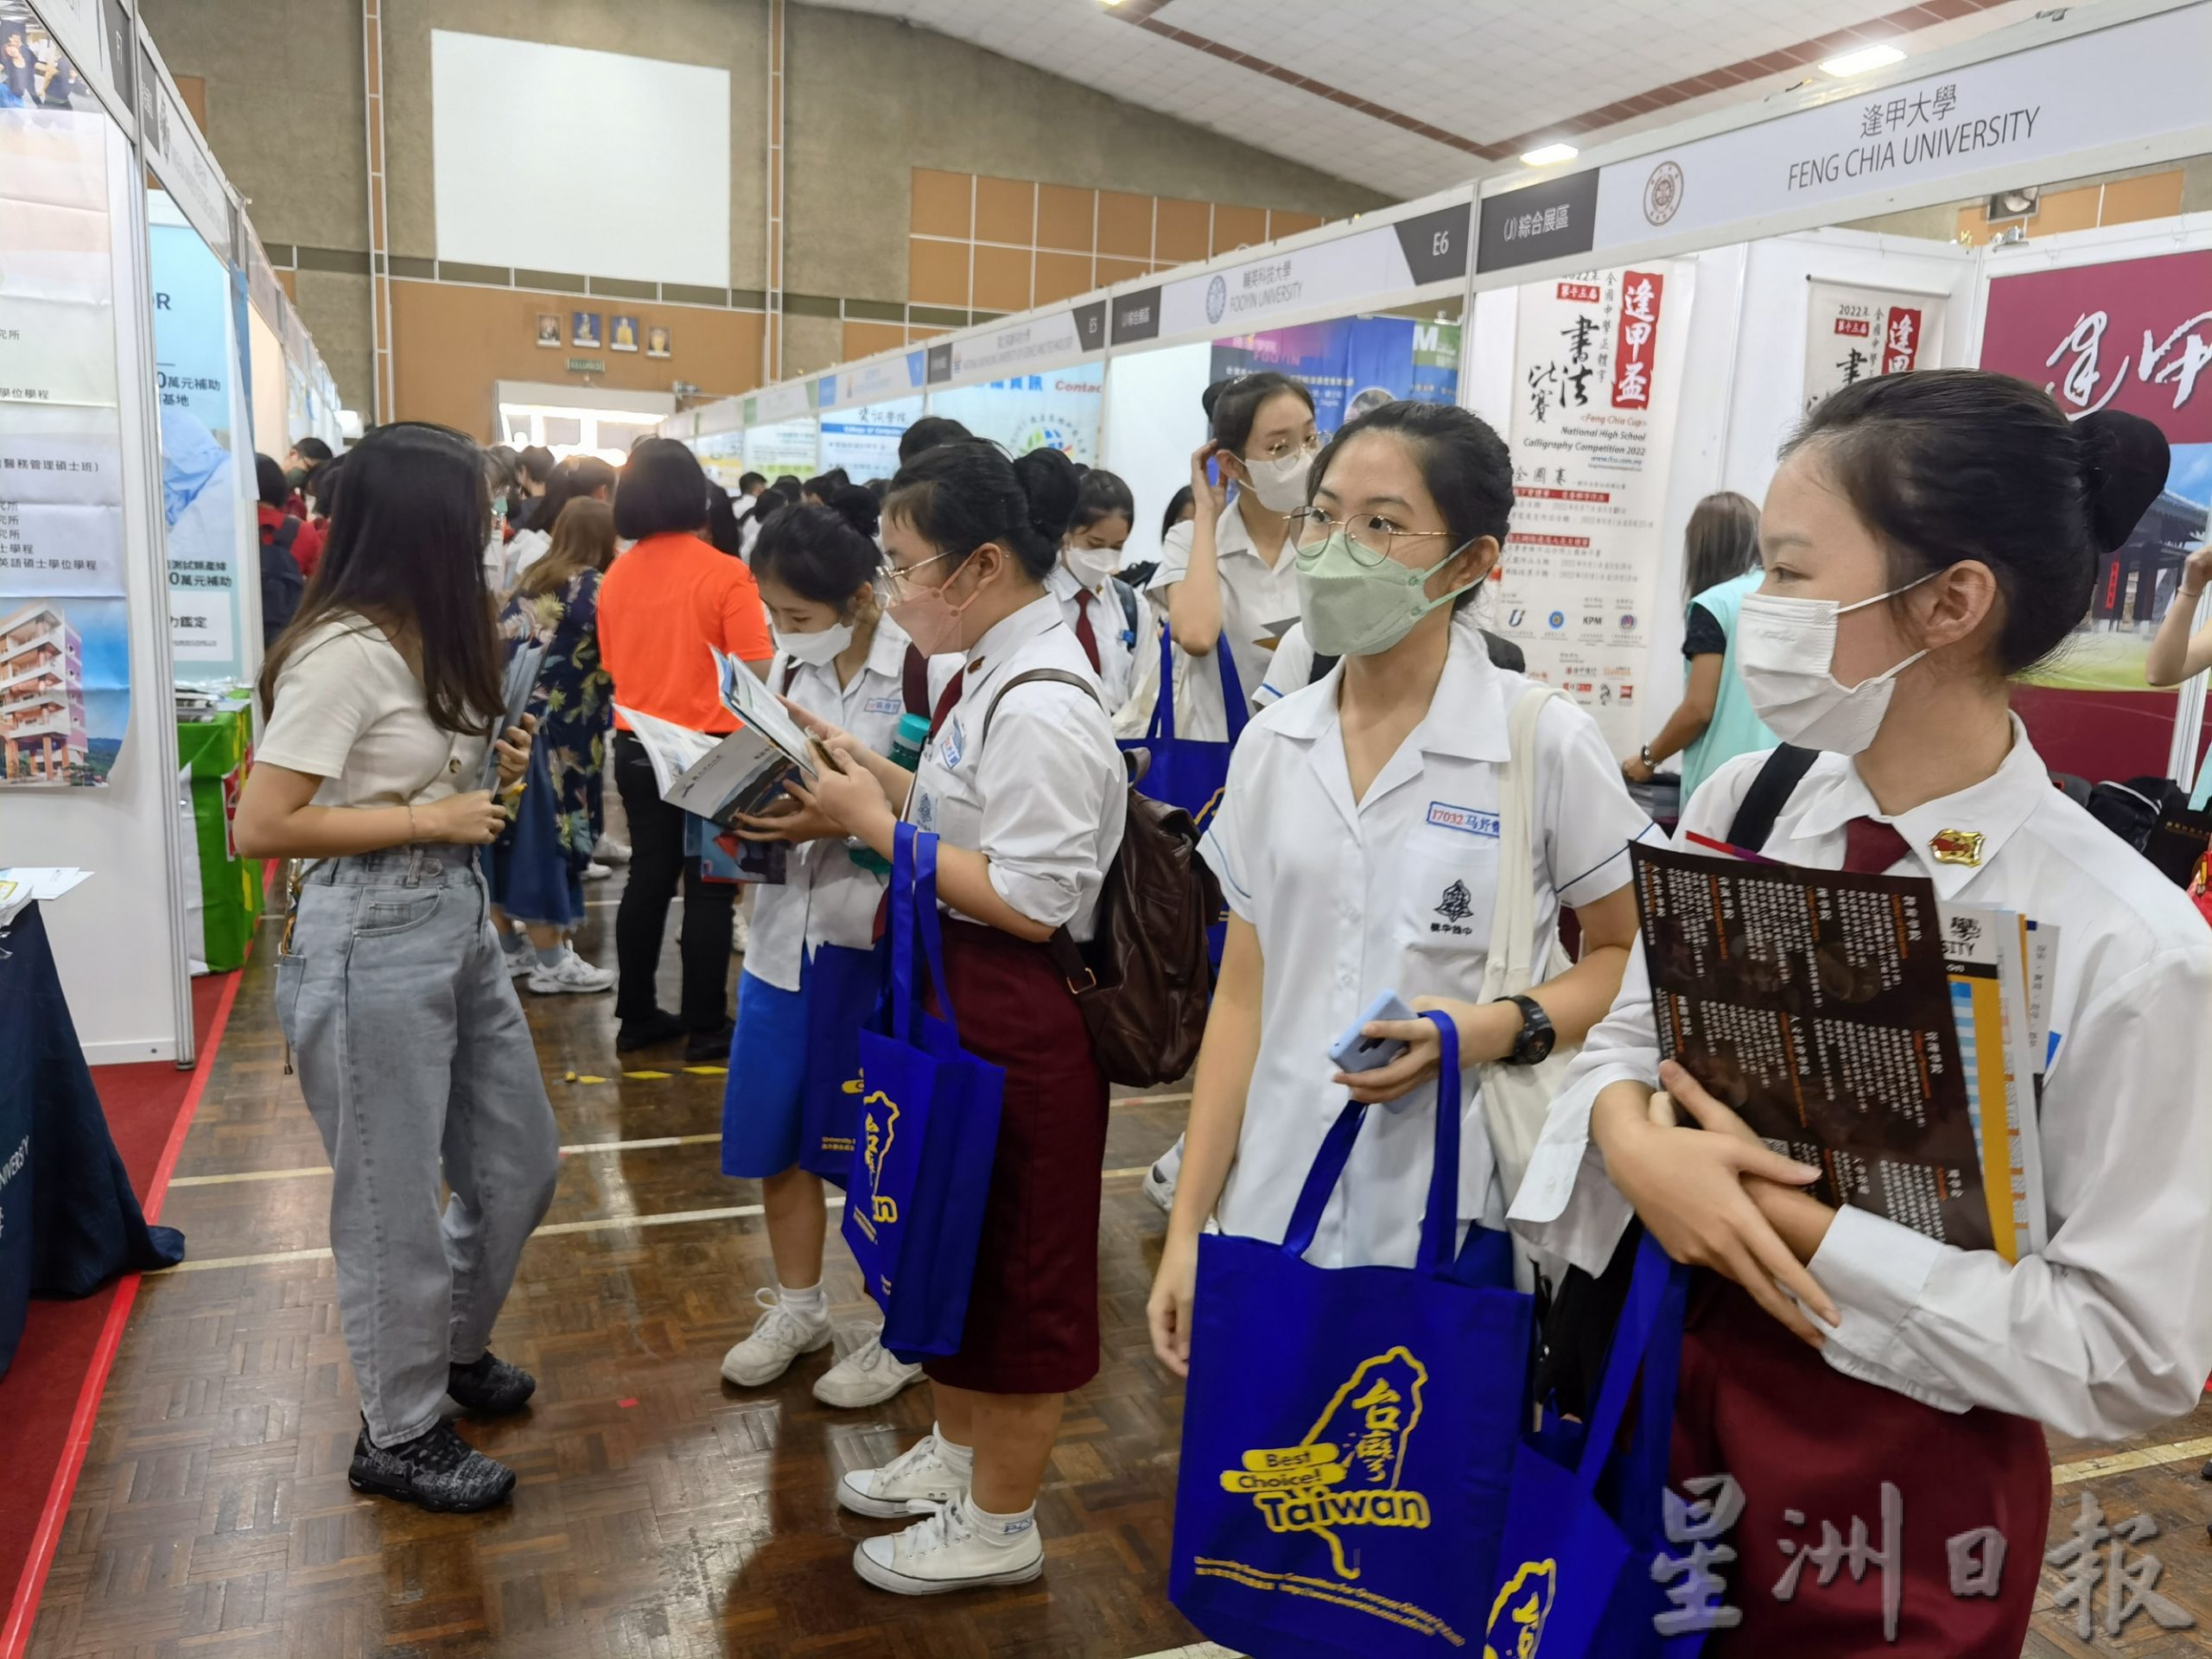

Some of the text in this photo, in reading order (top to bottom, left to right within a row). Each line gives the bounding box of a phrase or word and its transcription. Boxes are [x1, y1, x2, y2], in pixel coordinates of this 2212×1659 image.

[1860, 84, 1956, 138] 逢甲大學
[1788, 105, 2040, 191] FENG CHIA UNIVERSITY
[1433, 231, 1449, 257] E6
[1258, 281, 1303, 308] UNIVERSITY
[1616, 278, 1656, 403] 逢甲盃
[159, 393, 189, 407] 基地
[1607, 416, 1626, 425] Chia
[1560, 427, 1646, 442] National High School
[1523, 438, 1646, 455] Calligraphy Competition 2022
[1583, 616, 1602, 626] KPM
[1431, 809, 1464, 826] 17032
[1266, 1452, 1311, 1468] Best
[1238, 1468, 1322, 1489] Choice!
[1256, 1490, 1427, 1531] Taiwan
